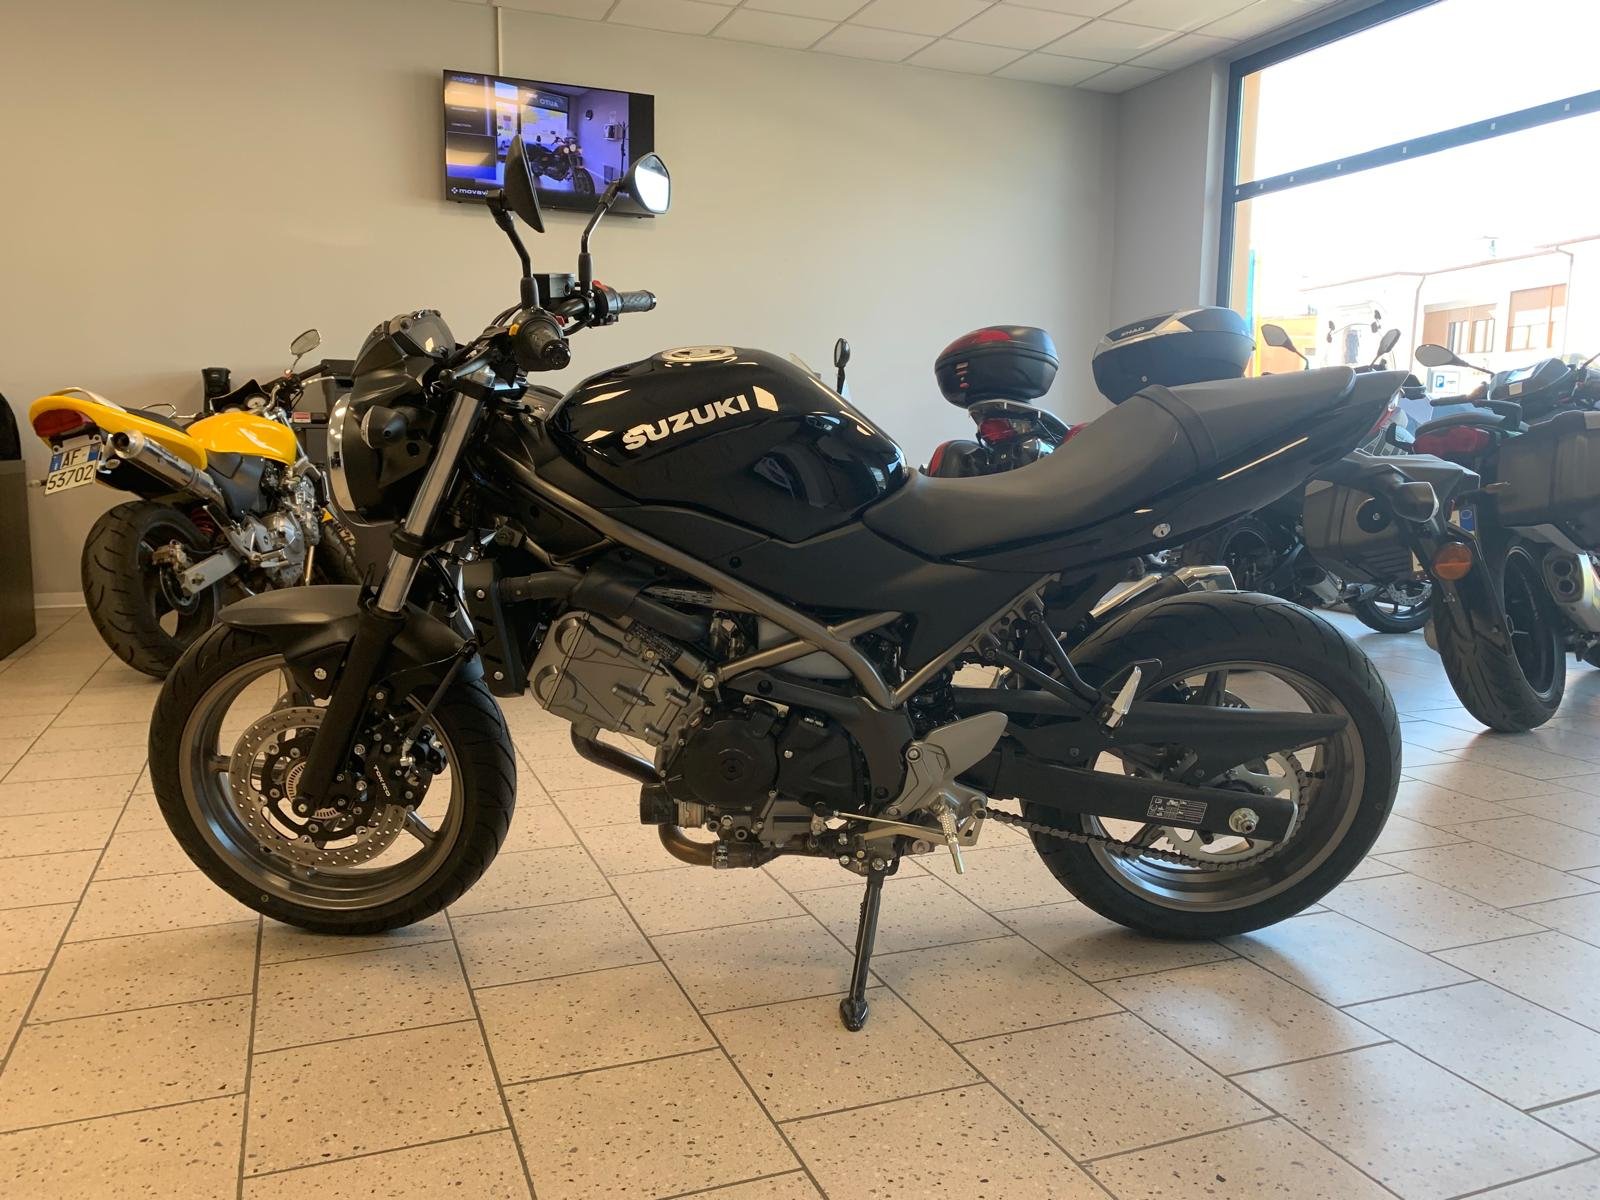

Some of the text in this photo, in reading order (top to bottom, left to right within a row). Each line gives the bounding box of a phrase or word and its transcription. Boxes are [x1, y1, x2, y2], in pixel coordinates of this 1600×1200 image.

[622, 394, 751, 451] SUZUKI
[62, 449, 81, 468] AF
[48, 464, 94, 490] 53702
[373, 764, 391, 797] TOKICO
